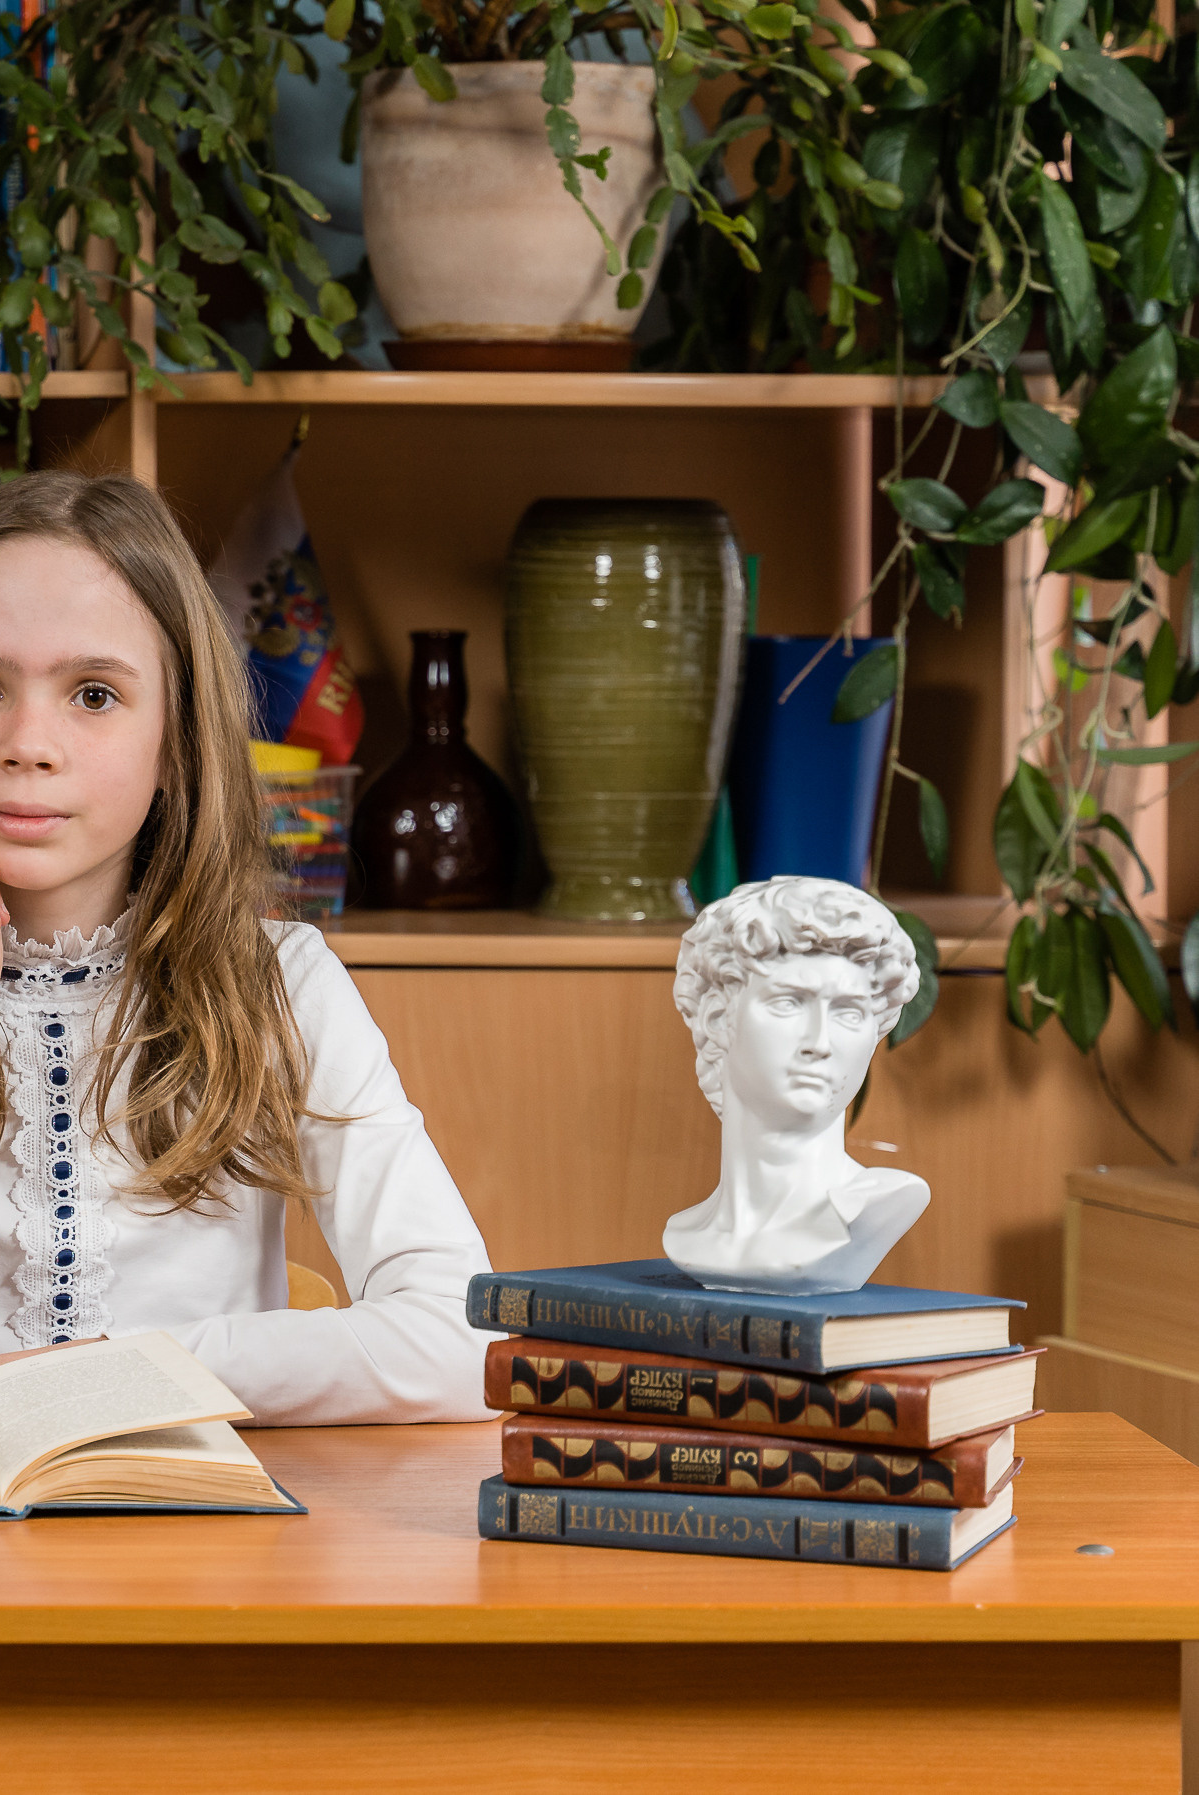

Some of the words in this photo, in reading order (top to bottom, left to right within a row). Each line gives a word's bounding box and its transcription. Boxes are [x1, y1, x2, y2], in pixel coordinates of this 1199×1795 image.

[629, 1369, 684, 1389] КУПЕР
[630, 1386, 684, 1401] Фенимор
[631, 1397, 679, 1412] Джеймс
[670, 1447, 722, 1465] КУПЕР
[671, 1463, 722, 1475] Фенимор
